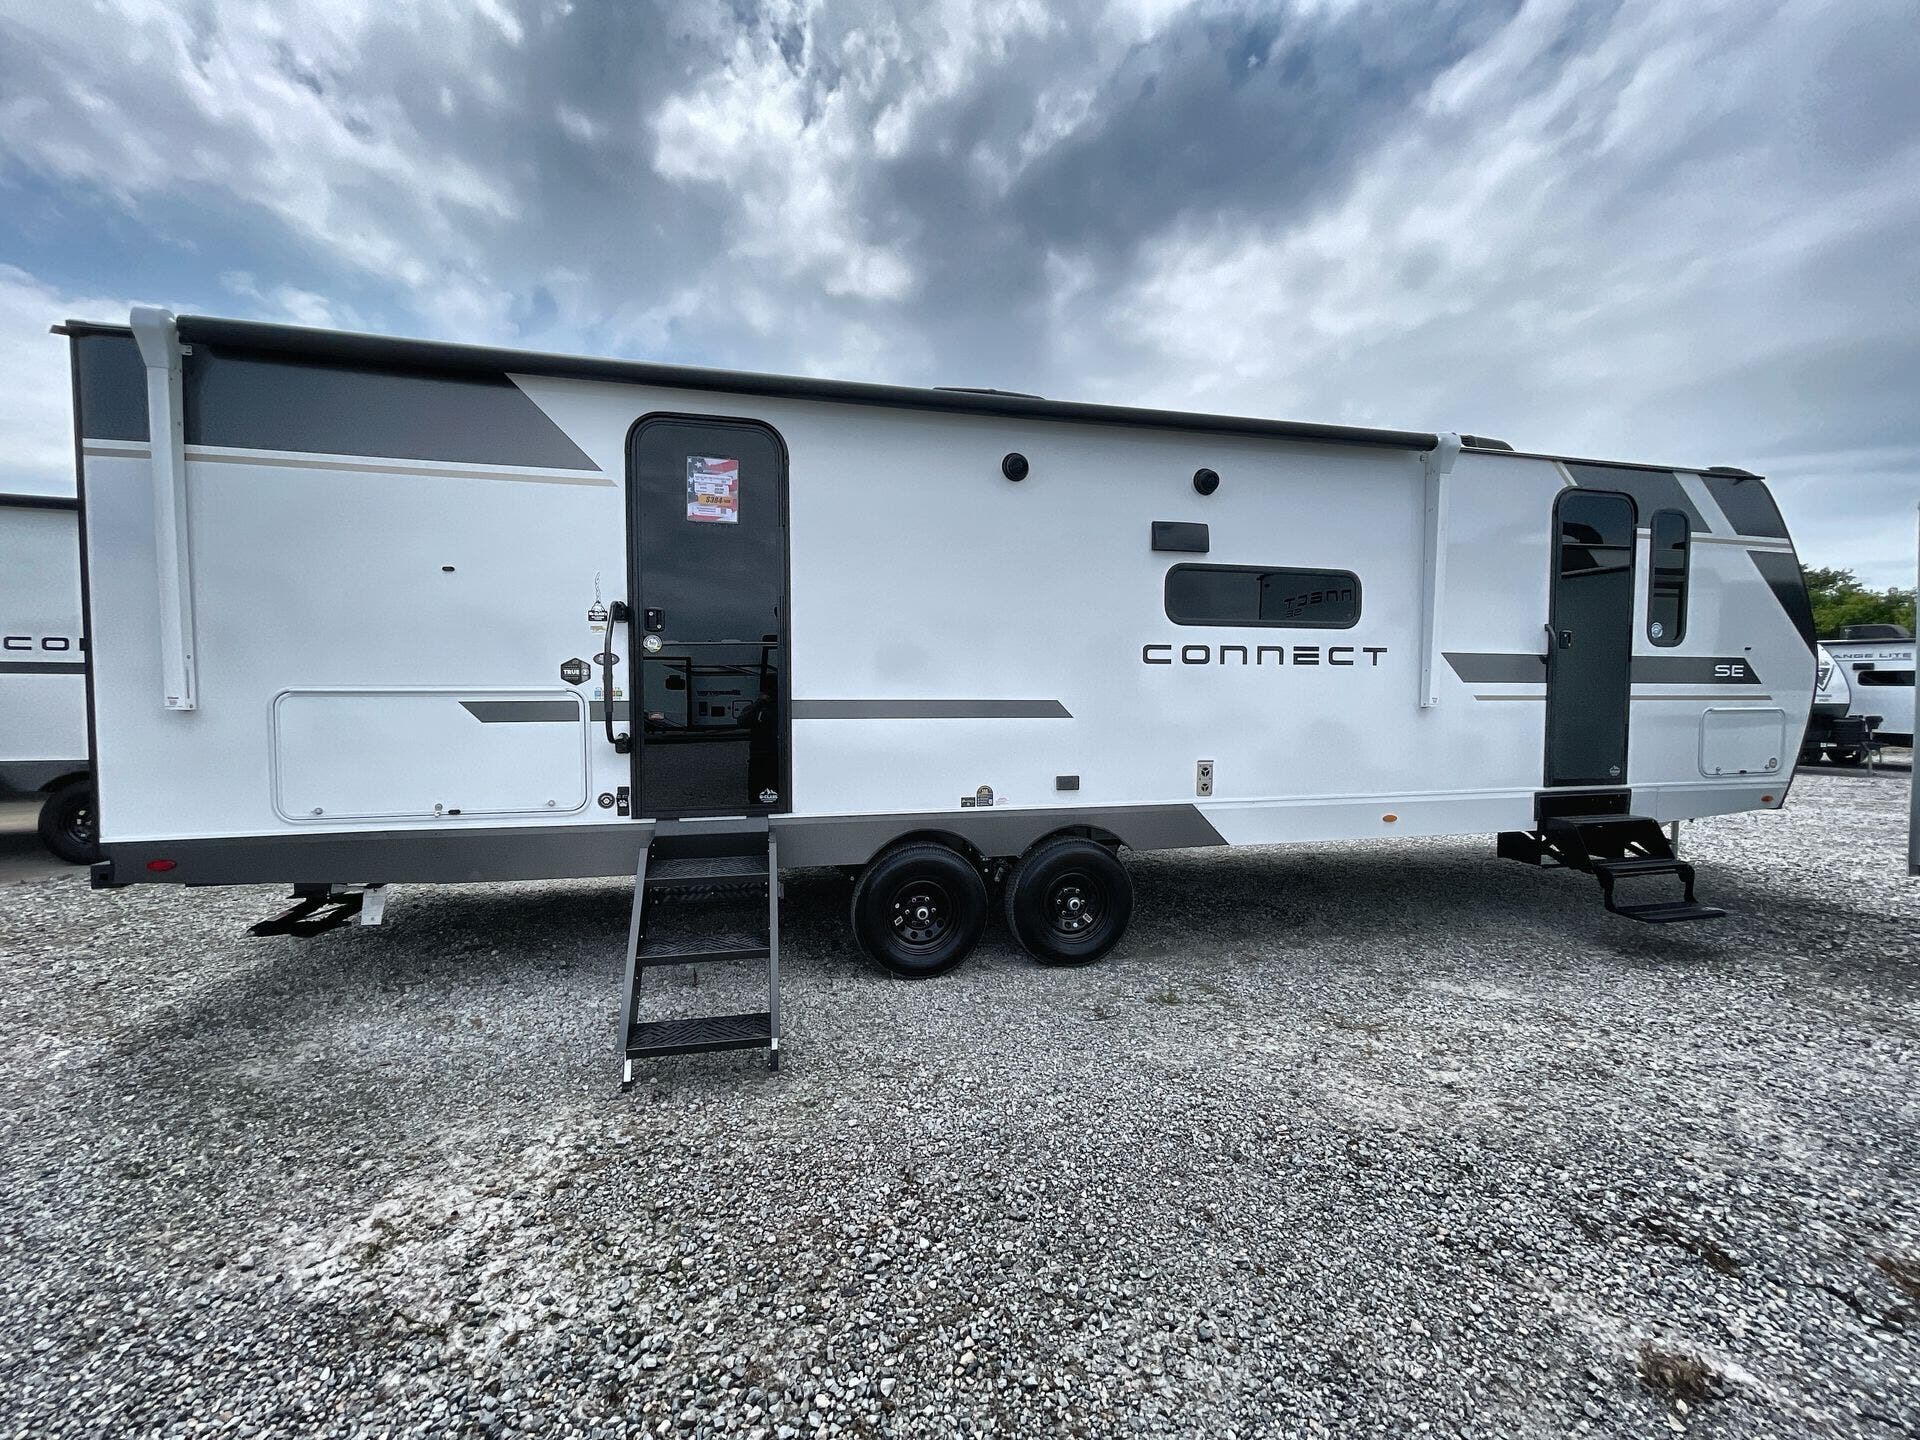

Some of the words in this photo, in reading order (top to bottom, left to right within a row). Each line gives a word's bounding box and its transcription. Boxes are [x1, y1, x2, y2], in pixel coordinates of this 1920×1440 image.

[3, 636, 84, 651] CO
[1142, 644, 1388, 666] CONNECT
[1714, 664, 1744, 677] SE
